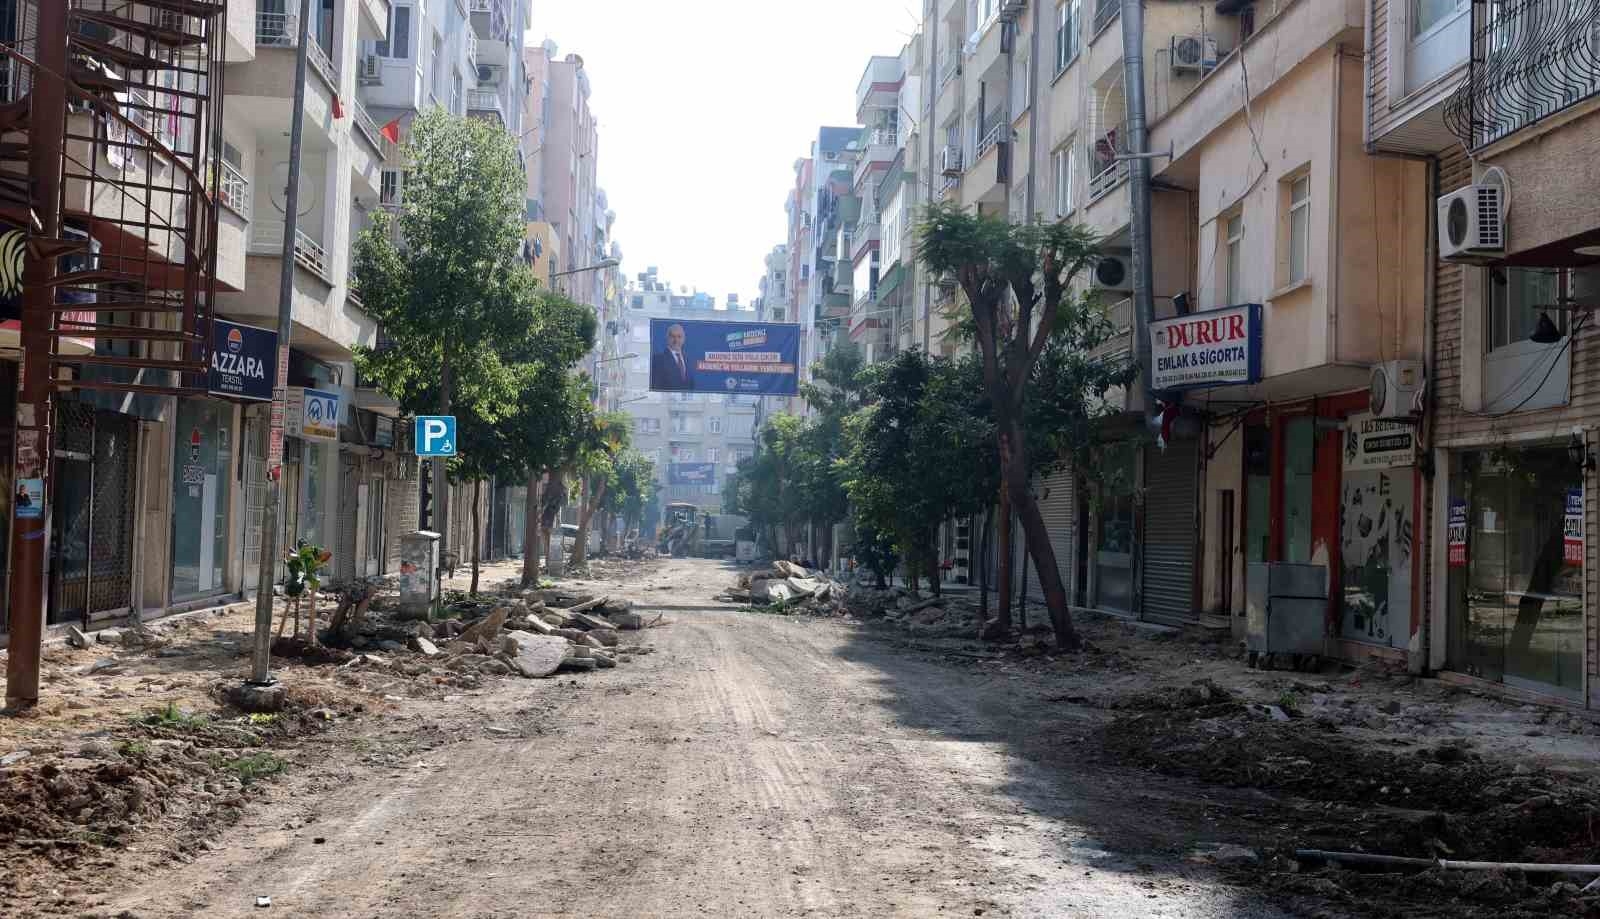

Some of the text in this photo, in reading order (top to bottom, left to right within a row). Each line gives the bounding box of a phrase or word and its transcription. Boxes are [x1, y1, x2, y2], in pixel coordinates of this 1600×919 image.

[1166, 314, 1247, 349] DURUR
[1191, 352, 1198, 367] &
[1200, 346, 1245, 365] SİGORTA
[425, 420, 448, 452] P
